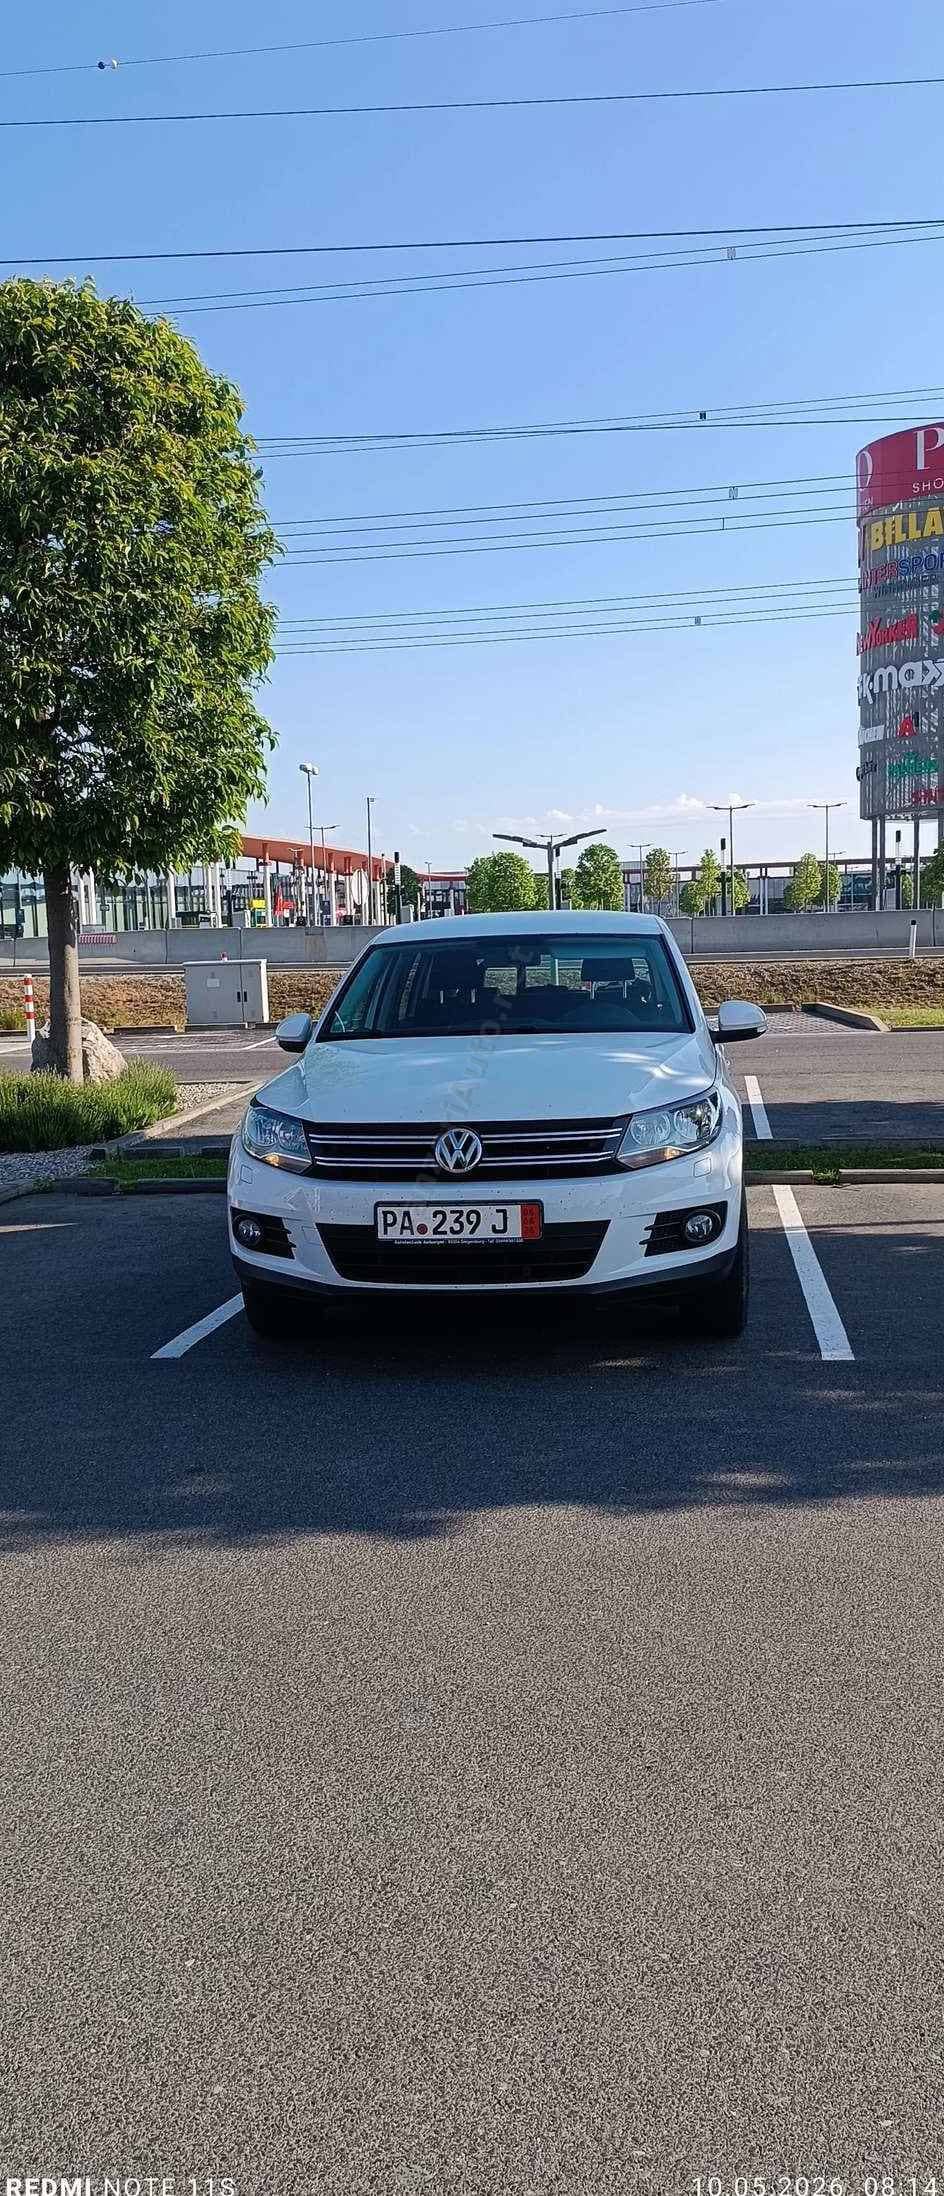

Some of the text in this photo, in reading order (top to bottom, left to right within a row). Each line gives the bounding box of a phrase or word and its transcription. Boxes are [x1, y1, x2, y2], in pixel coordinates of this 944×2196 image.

[872, 507, 944, 551] BILLA
[382, 1208, 508, 1235] PA 239 J
